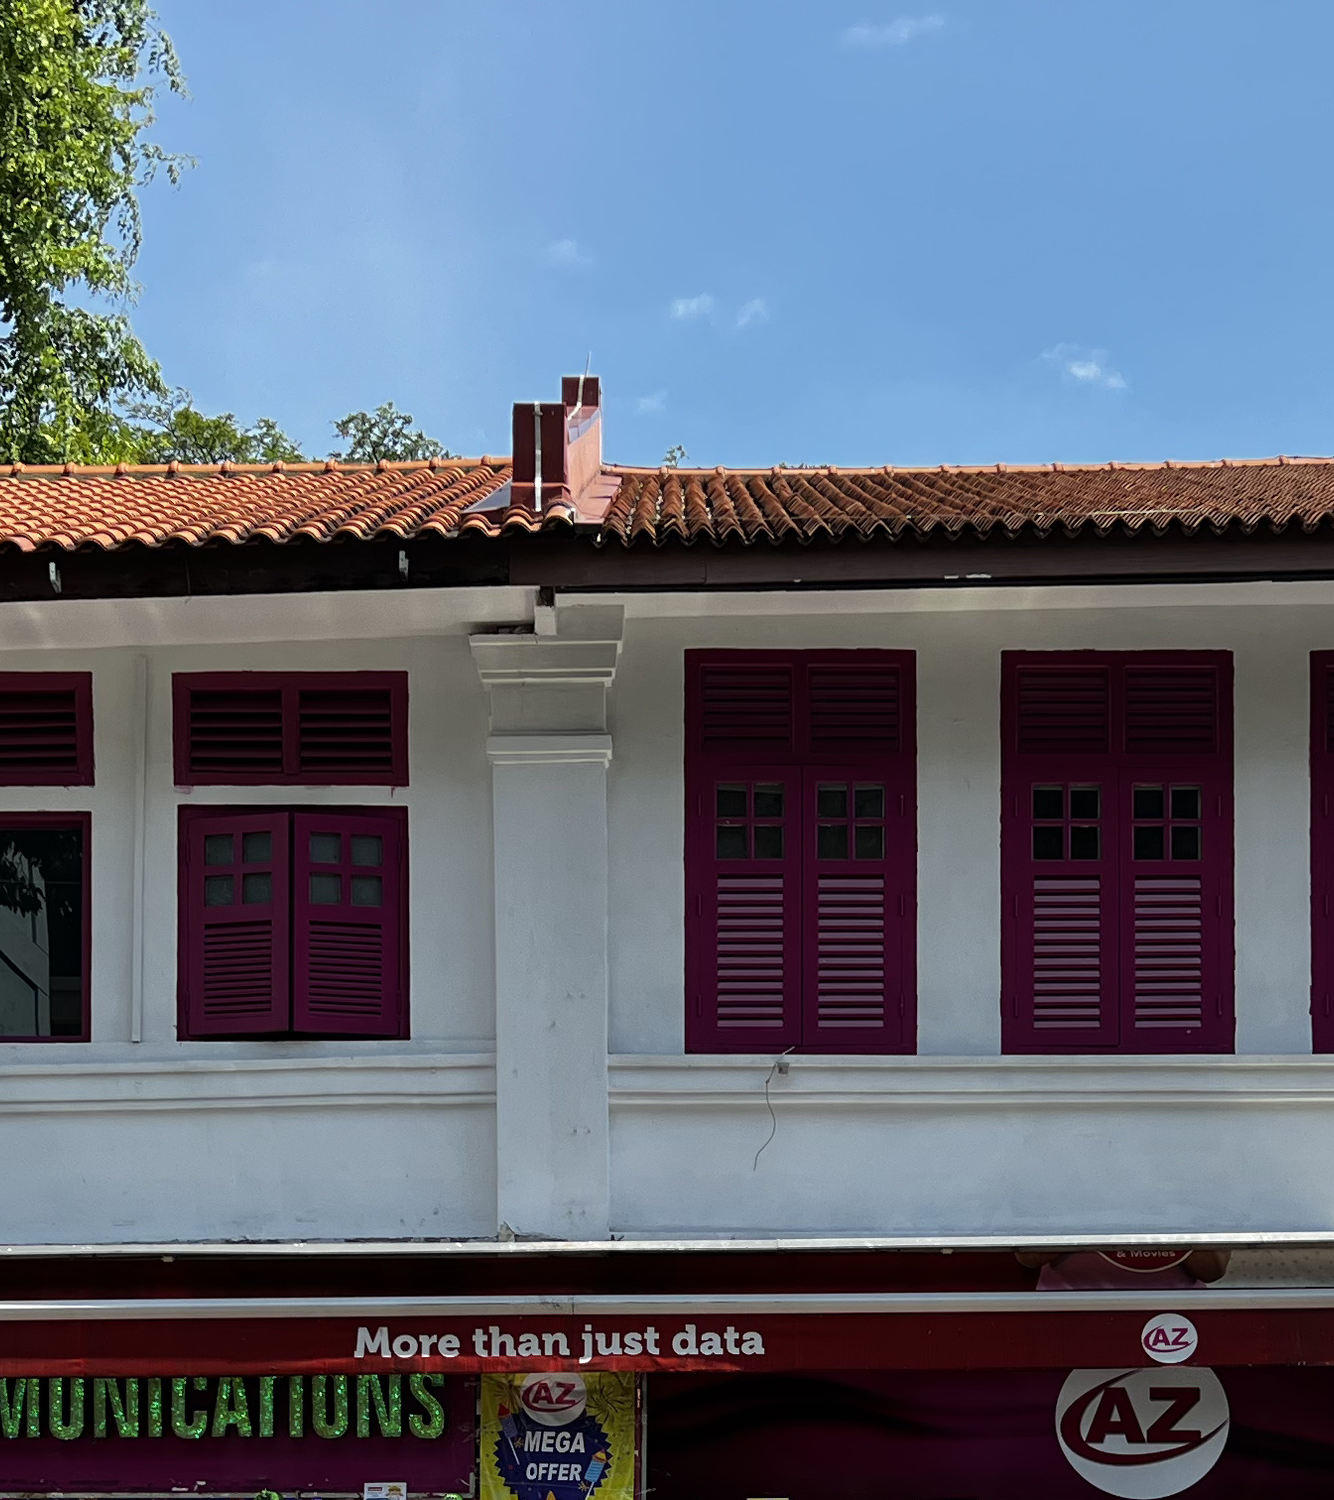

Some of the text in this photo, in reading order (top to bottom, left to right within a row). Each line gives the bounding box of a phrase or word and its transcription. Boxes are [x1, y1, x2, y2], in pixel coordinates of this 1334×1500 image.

[353, 1325, 765, 1364] More than just data
[1148, 1327, 1190, 1348] AZ
[525, 1379, 578, 1408] AZ
[1077, 1384, 1207, 1448] AZ
[523, 1431, 586, 1454] MEGA
[525, 1462, 583, 1482] OFFER
